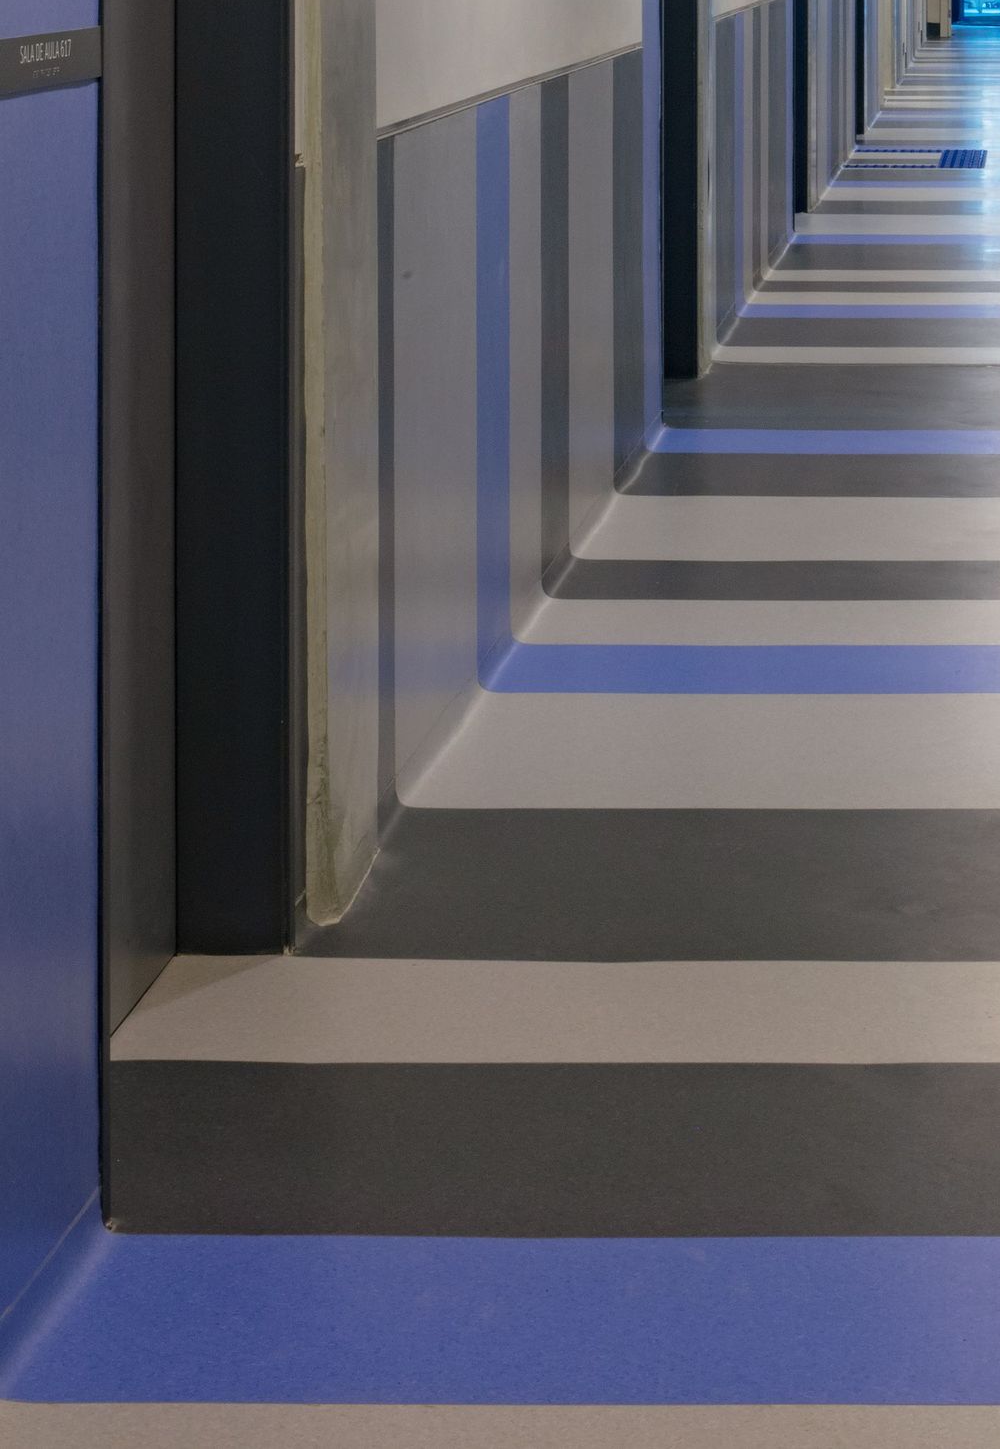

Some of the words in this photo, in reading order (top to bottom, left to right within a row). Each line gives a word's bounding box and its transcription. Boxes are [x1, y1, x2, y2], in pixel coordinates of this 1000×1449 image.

[20, 45, 34, 64] SALA
[35, 43, 44, 62] DE
[45, 41, 60, 60] AULA
[60, 39, 72, 58] 617
